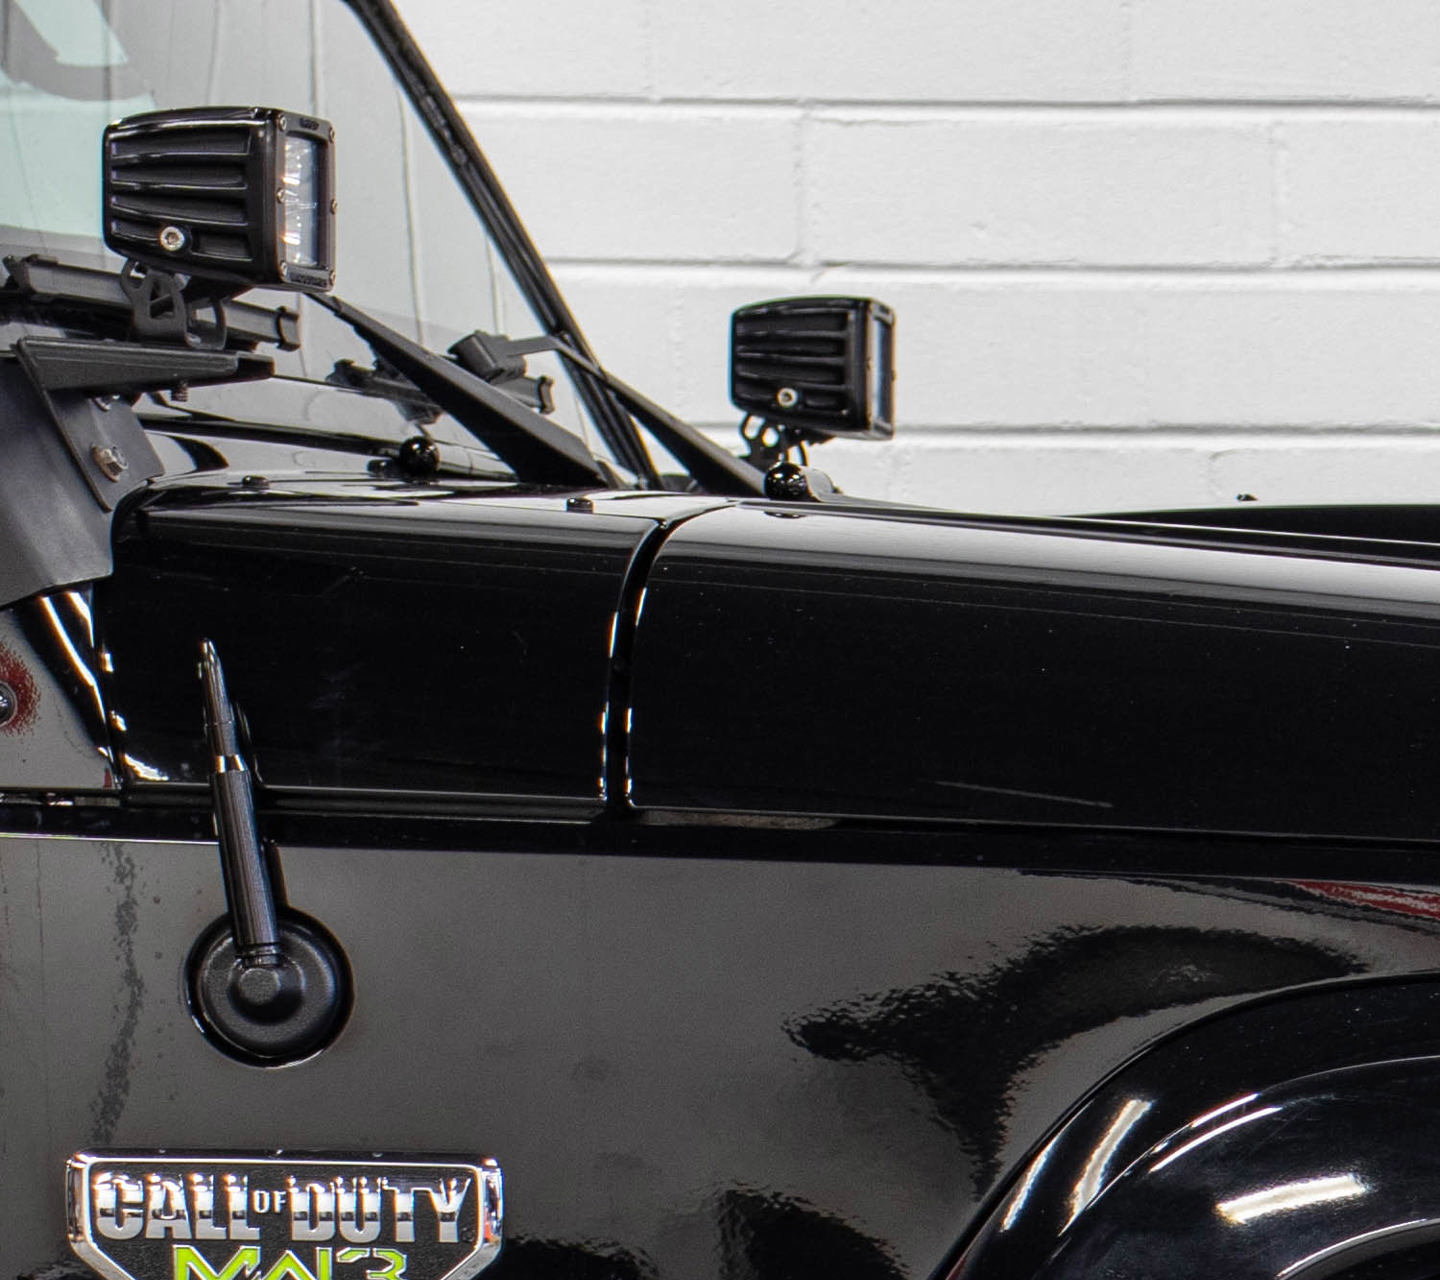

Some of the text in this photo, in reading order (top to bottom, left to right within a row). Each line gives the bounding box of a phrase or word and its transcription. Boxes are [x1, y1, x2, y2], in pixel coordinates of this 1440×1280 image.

[94, 1173, 473, 1243] CALL OF DUTY
